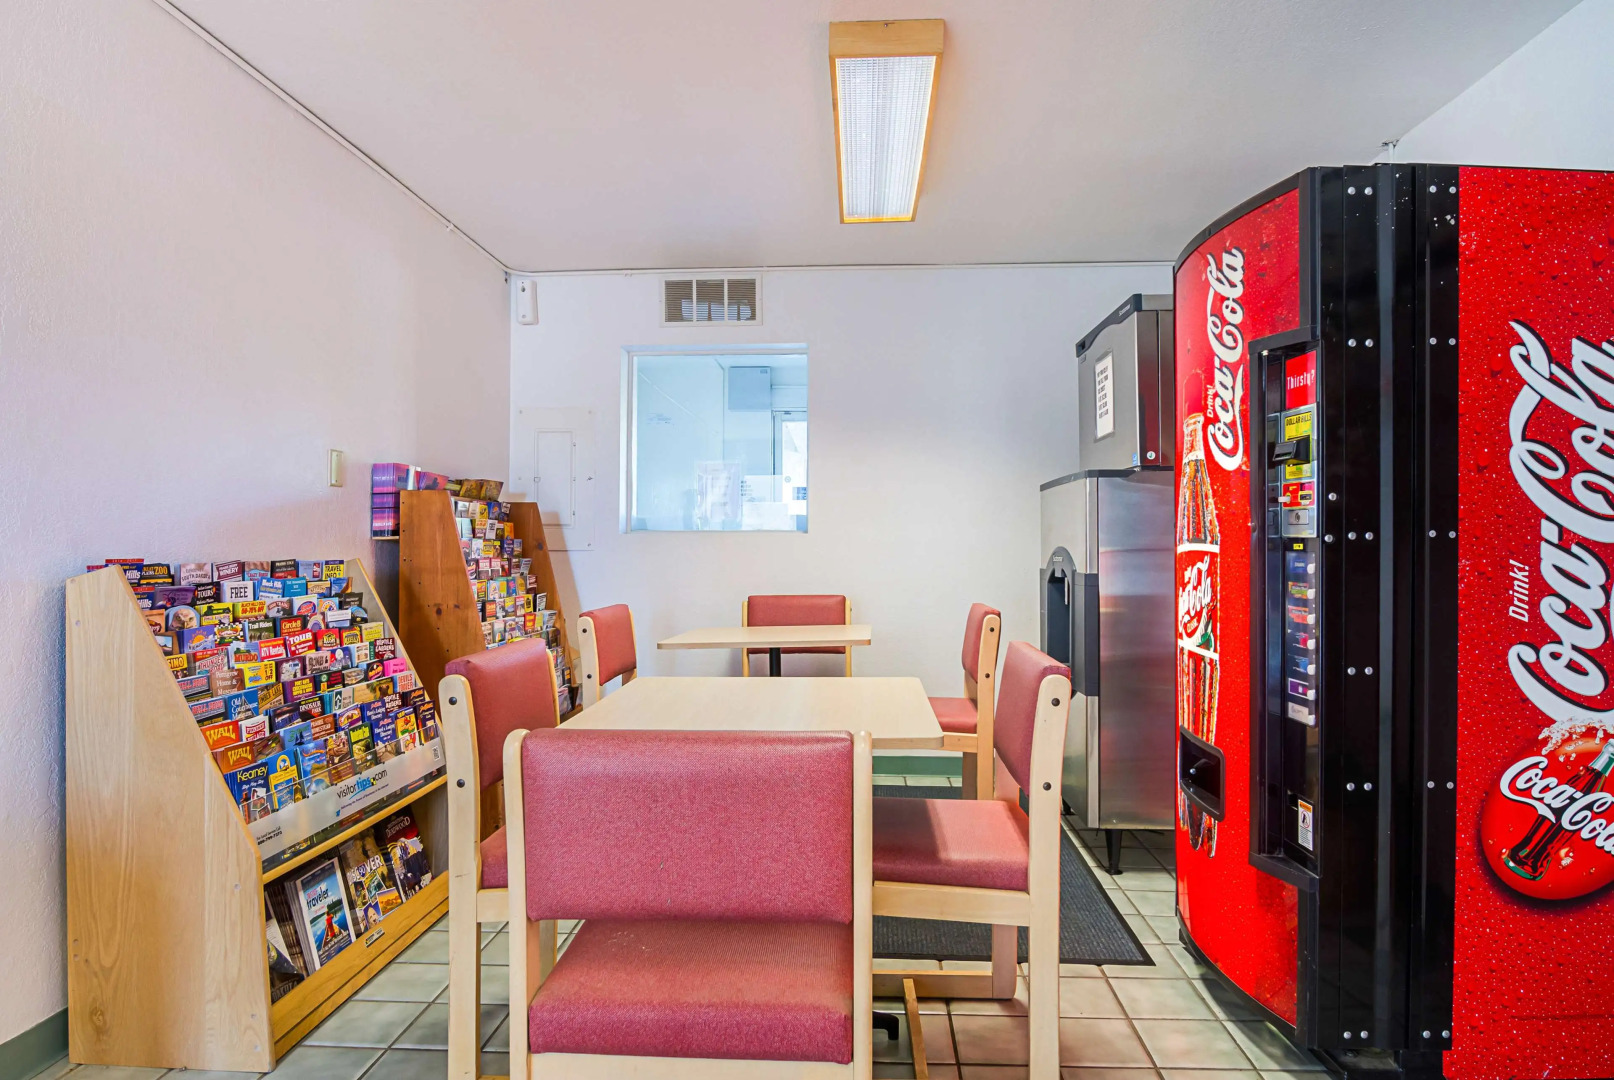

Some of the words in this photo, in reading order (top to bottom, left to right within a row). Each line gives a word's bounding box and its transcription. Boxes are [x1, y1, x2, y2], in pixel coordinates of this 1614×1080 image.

[1207, 246, 1245, 471] Coca-Cola
[1287, 369, 1315, 390] Thirsty?
[1207, 385, 1215, 418] Drink!
[1286, 416, 1300, 426] DOLLAR
[1301, 413, 1312, 423] BILLS
[1508, 319, 1614, 726] Coca-Cola
[154, 566, 168, 576] ZOO
[182, 573, 194, 581] SOUTH
[219, 567, 239, 576] WINERY
[198, 589, 214, 598] TOURS
[230, 586, 248, 599] FREE
[1508, 560, 1529, 622] Drink!
[283, 621, 297, 629] Circle
[289, 632, 312, 644] TOUR
[261, 647, 269, 657] ATV
[375, 644, 394, 653] GARDENS
[234, 653, 258, 662] MURDO
[231, 696, 241, 706] Old
[299, 700, 322, 712] DINOSAUR
[206, 725, 236, 745] WALL
[227, 746, 251, 766] WALL
[237, 765, 268, 782] Kearney
[307, 887, 329, 910] traveler
